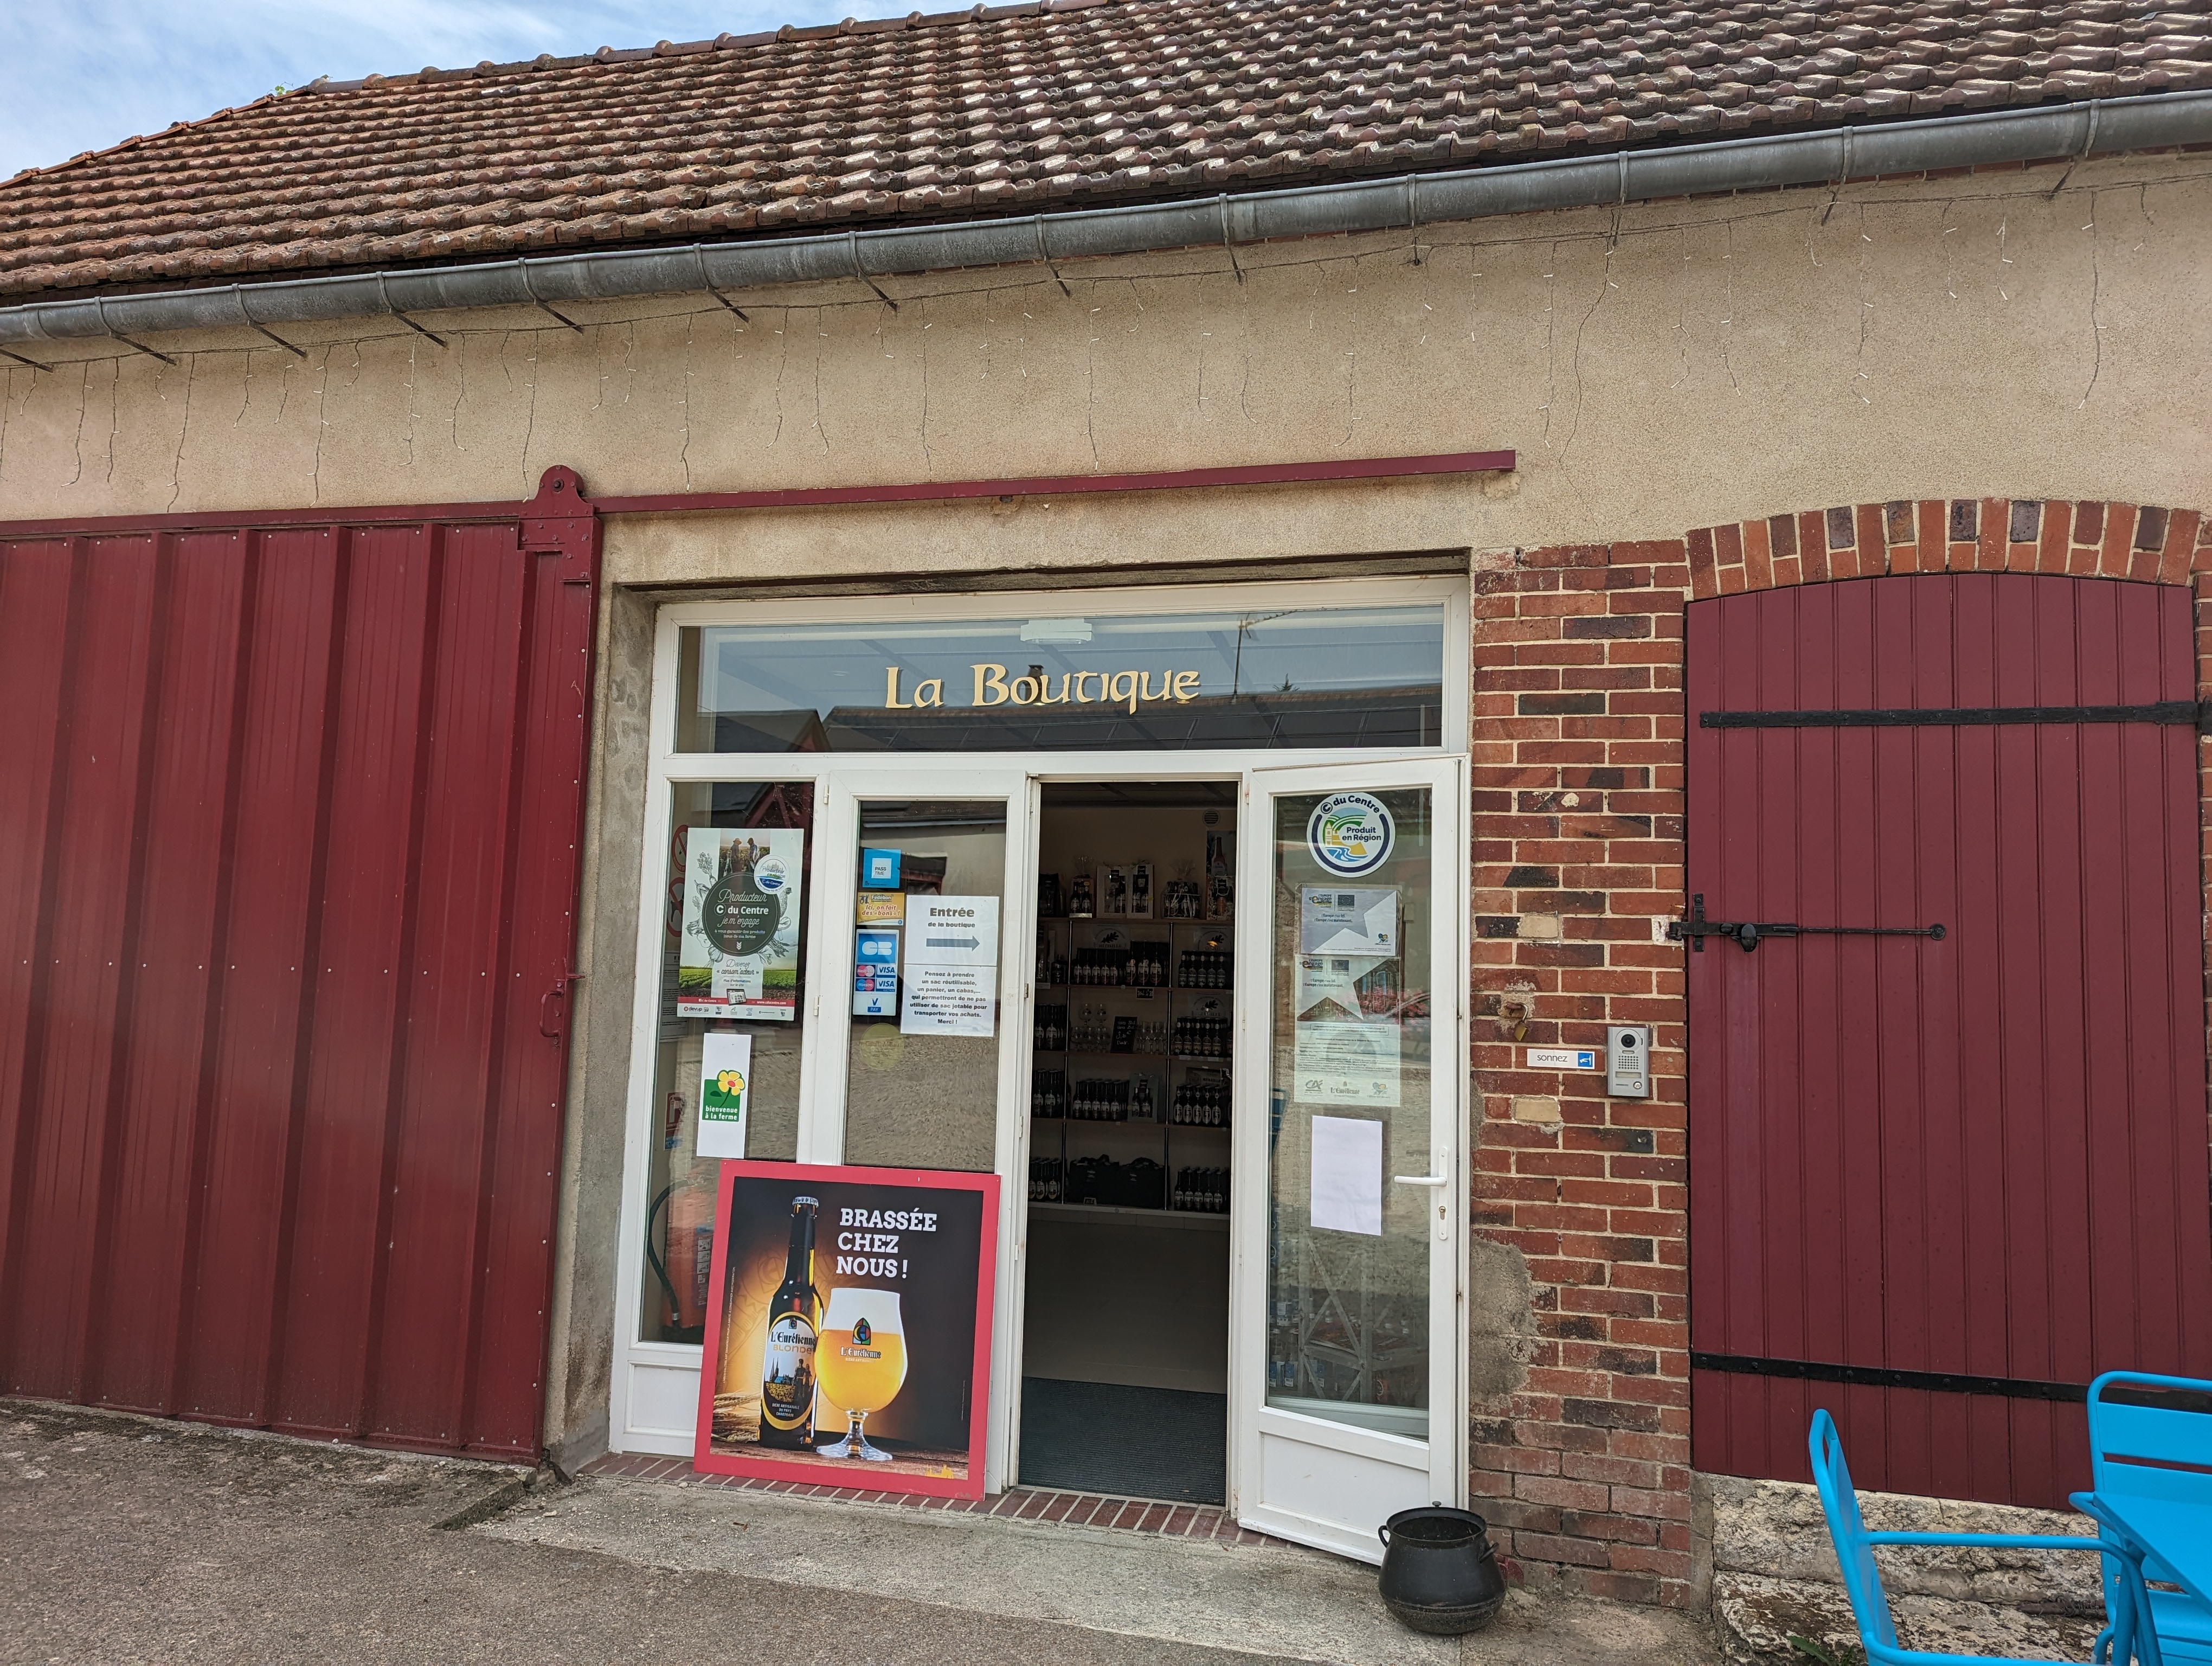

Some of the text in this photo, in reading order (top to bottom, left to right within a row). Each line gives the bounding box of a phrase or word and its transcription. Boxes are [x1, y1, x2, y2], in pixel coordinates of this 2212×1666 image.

[885, 664, 1200, 715] La Boutique
[1333, 797, 1347, 806] du
[1348, 795, 1380, 813] Centre
[1353, 834, 1381, 842] Région
[717, 889, 768, 902] Producteur
[728, 906, 738, 914] du
[741, 906, 769, 915] Centre
[929, 907, 975, 917] Entrée
[872, 998, 878, 1006] V
[1537, 1054, 1567, 1062] sonnez
[840, 1207, 937, 1232] BRASSÉE
[838, 1232, 899, 1253] CHEZ
[836, 1256, 898, 1278] NOUS
[770, 1331, 815, 1345] L'Eurélienne
[841, 1347, 881, 1359] L'Eurélienne
